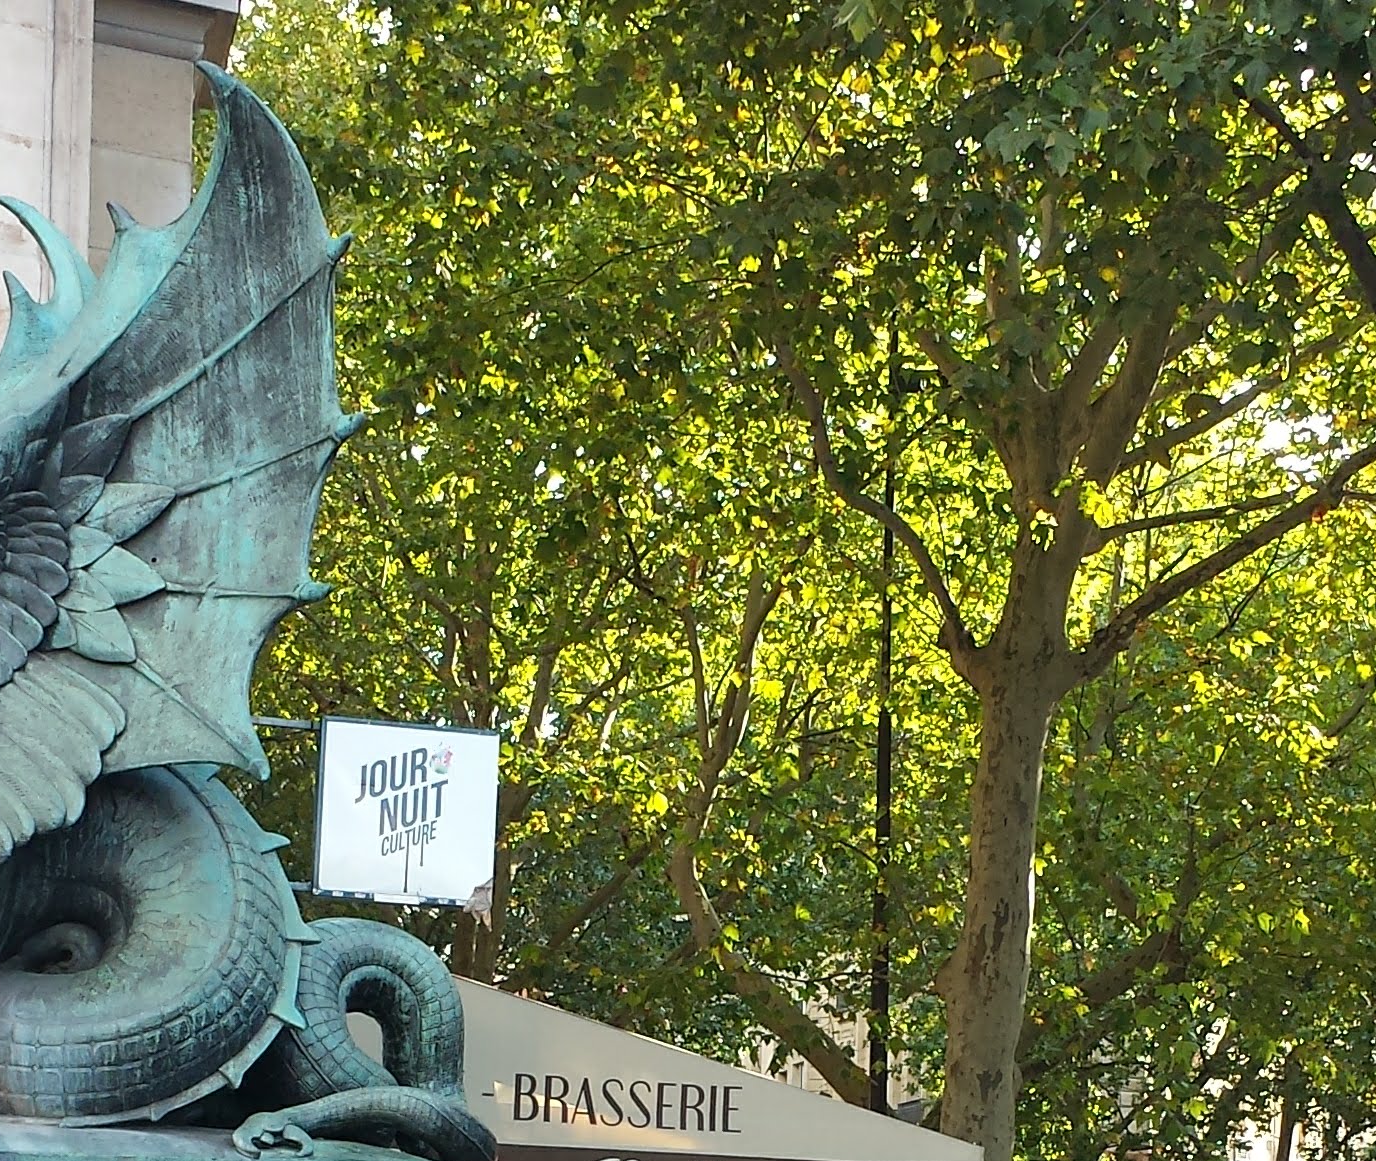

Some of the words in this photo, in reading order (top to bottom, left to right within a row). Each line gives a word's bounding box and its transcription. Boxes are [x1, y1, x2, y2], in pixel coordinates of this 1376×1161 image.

[355, 748, 428, 804] JOUR
[379, 779, 448, 836] NUIT
[381, 820, 438, 866] CULTURE
[513, 1073, 744, 1134] BRASSERIE
